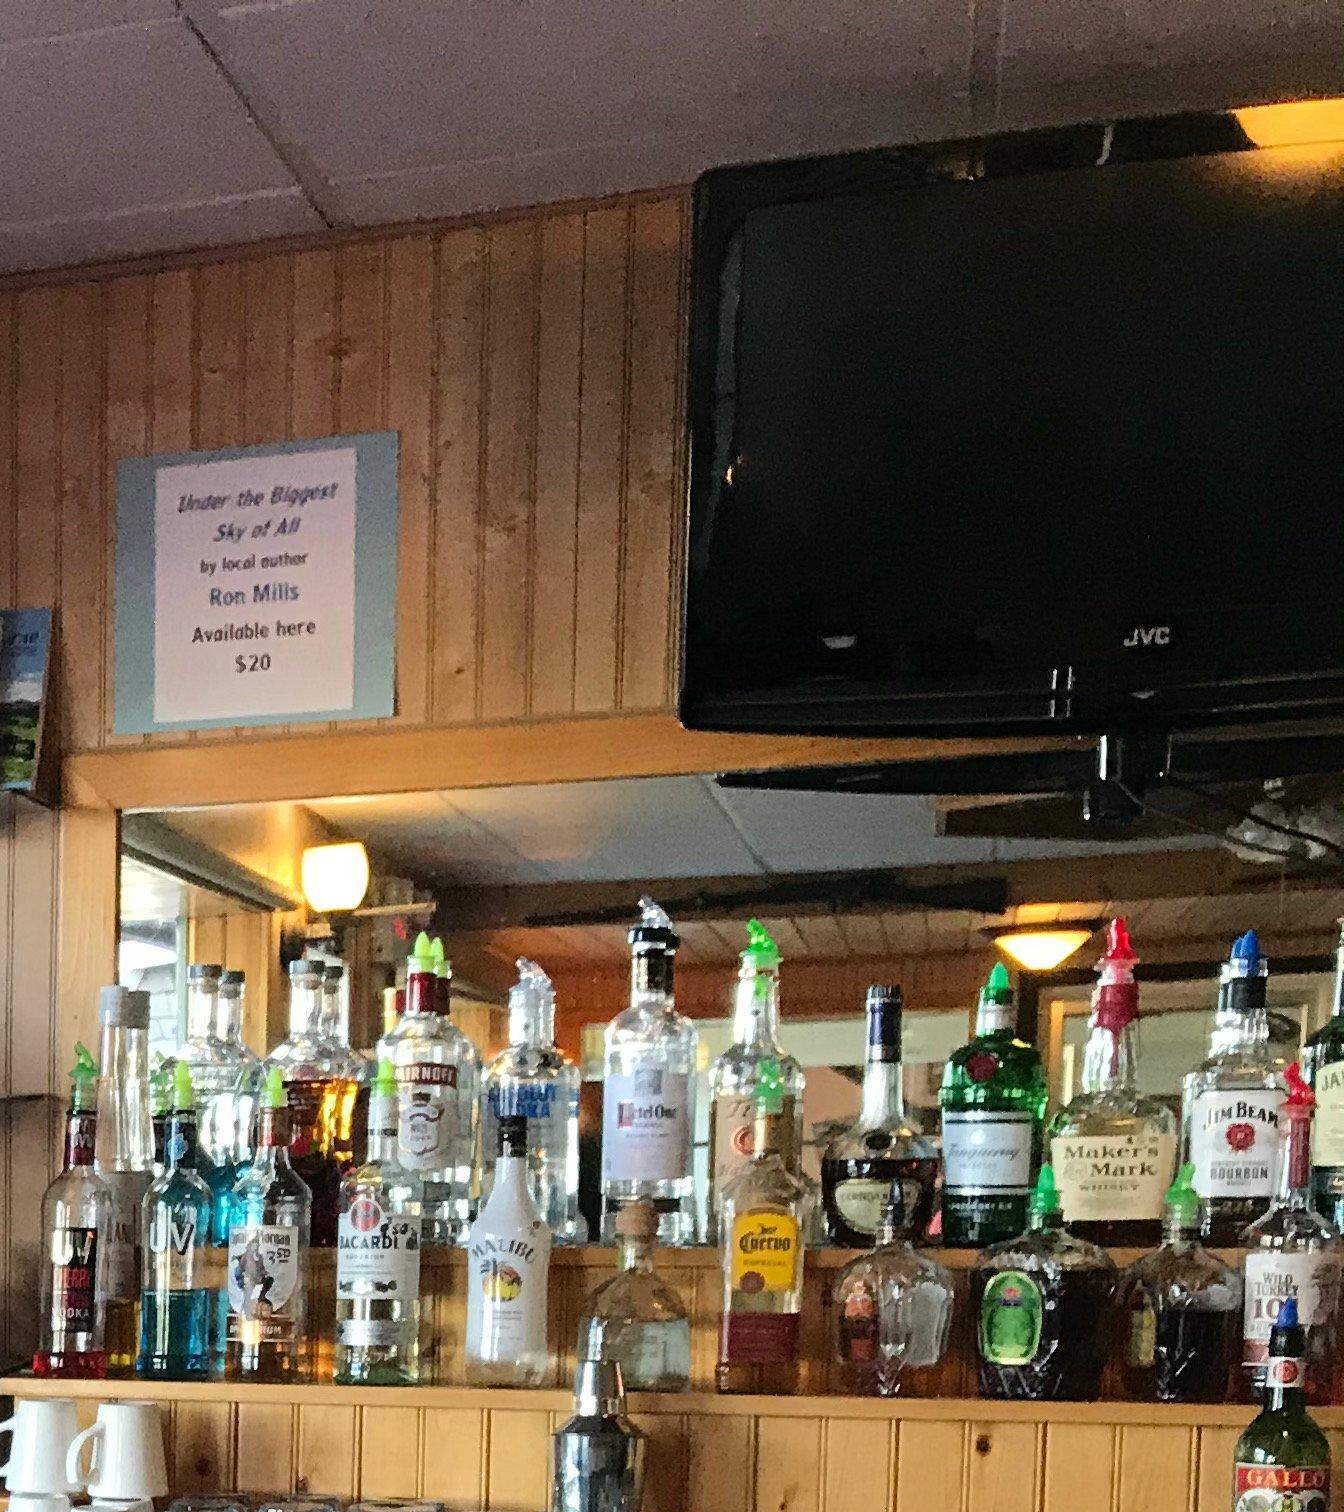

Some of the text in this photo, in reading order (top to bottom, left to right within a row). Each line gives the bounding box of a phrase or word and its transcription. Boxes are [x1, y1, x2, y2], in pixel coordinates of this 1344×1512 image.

[177, 482, 340, 514] Under the Biggest
[213, 522, 246, 543] Sky
[274, 516, 302, 536] All
[200, 552, 310, 576] by local author
[209, 582, 300, 607] Ron Mills
[191, 620, 317, 644] Available here
[1123, 627, 1171, 647] JVC
[235, 653, 272, 675] $20
[1064, 1145, 1159, 1159] Maker's
[1089, 1162, 1158, 1177] Mark
[1210, 1167, 1268, 1180] BOURBON
[149, 1221, 195, 1256] UV
[261, 1232, 292, 1247] organ
[739, 1231, 791, 1254] Cuervo
[1263, 1271, 1293, 1284] WILD
[55, 1306, 90, 1319] ODKA
[1246, 1469, 1326, 1488] GALLO
